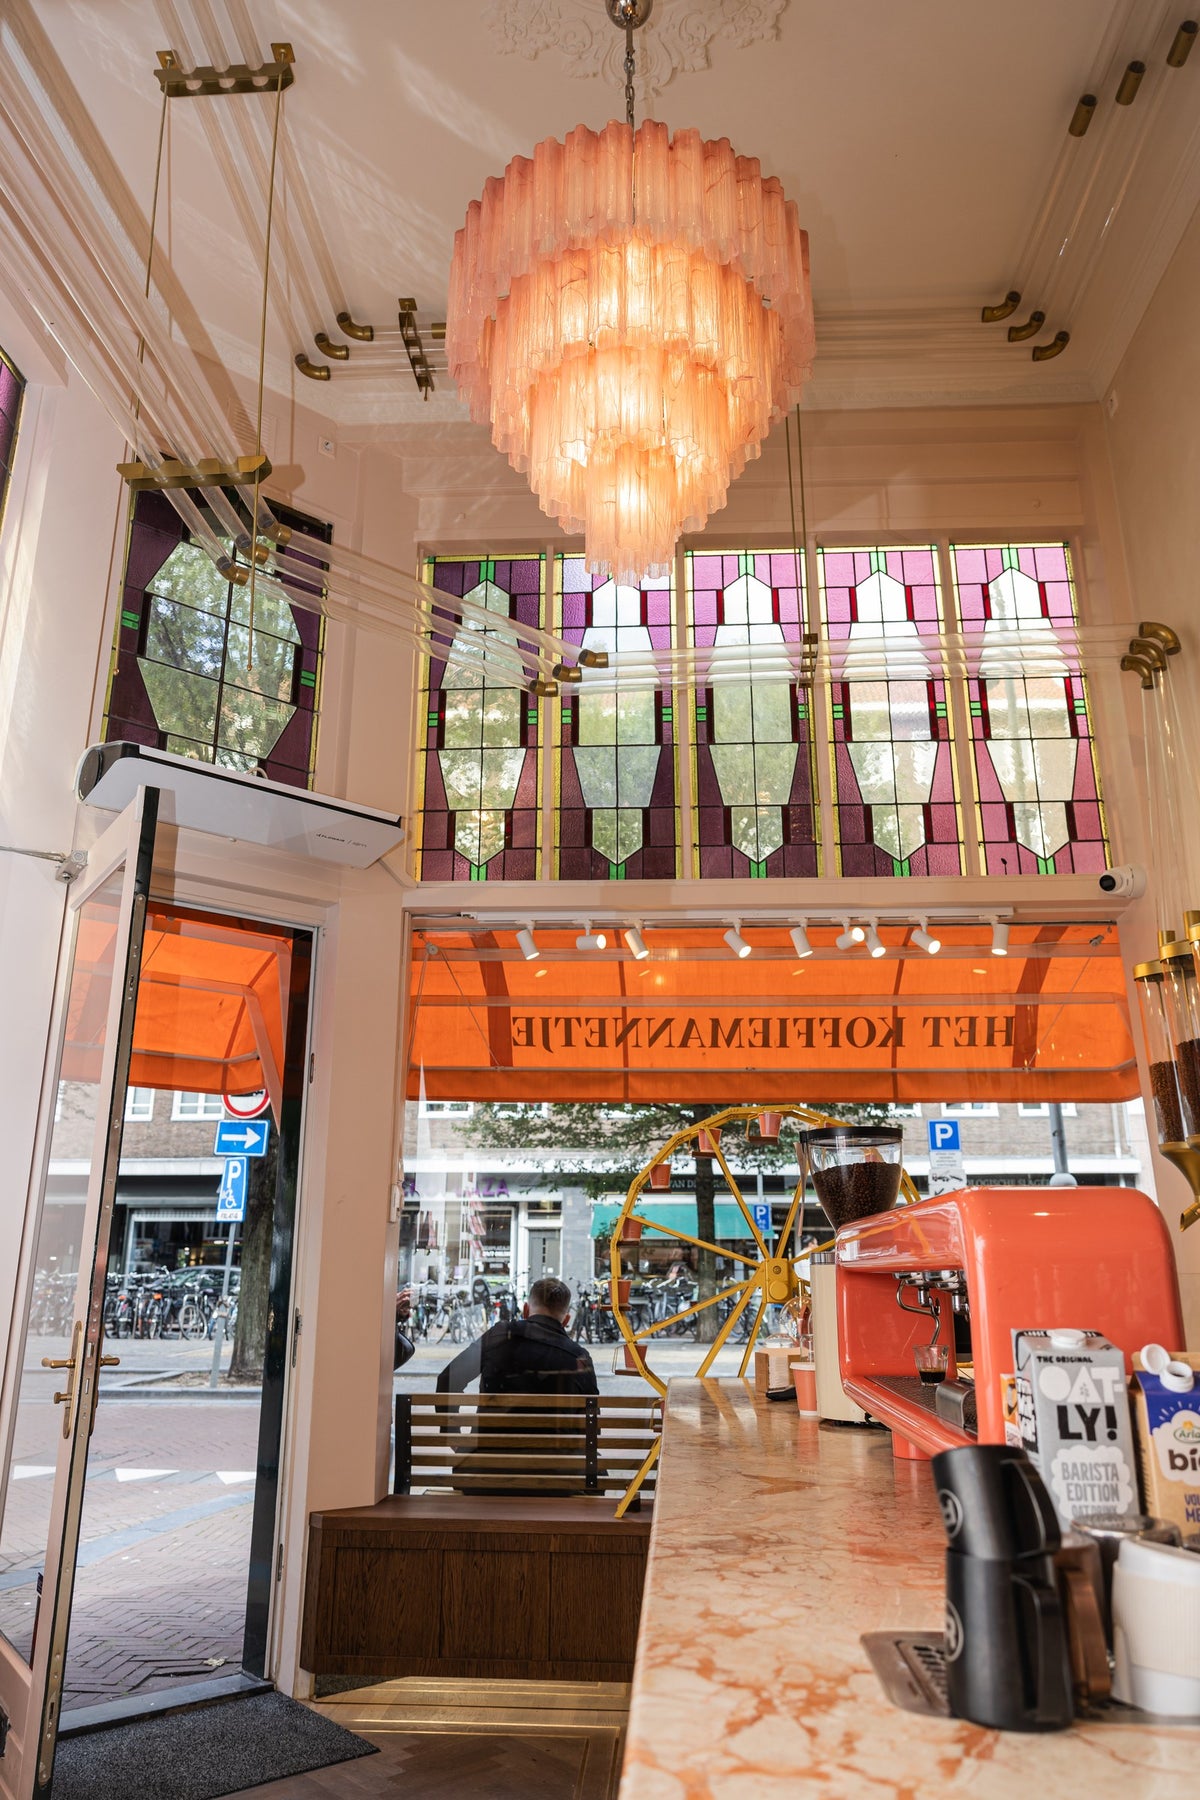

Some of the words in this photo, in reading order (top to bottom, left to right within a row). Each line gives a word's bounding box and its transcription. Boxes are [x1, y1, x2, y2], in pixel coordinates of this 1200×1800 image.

[935, 1123, 953, 1148] P
[227, 1161, 242, 1188] P
[756, 1206, 766, 1219] P
[1039, 1366, 1124, 1403] OAT-
[1057, 1404, 1117, 1441] LY!
[1061, 1462, 1119, 1480] BARISTA
[1168, 1449, 1200, 1471] bi
[1066, 1483, 1120, 1502] EDITION
